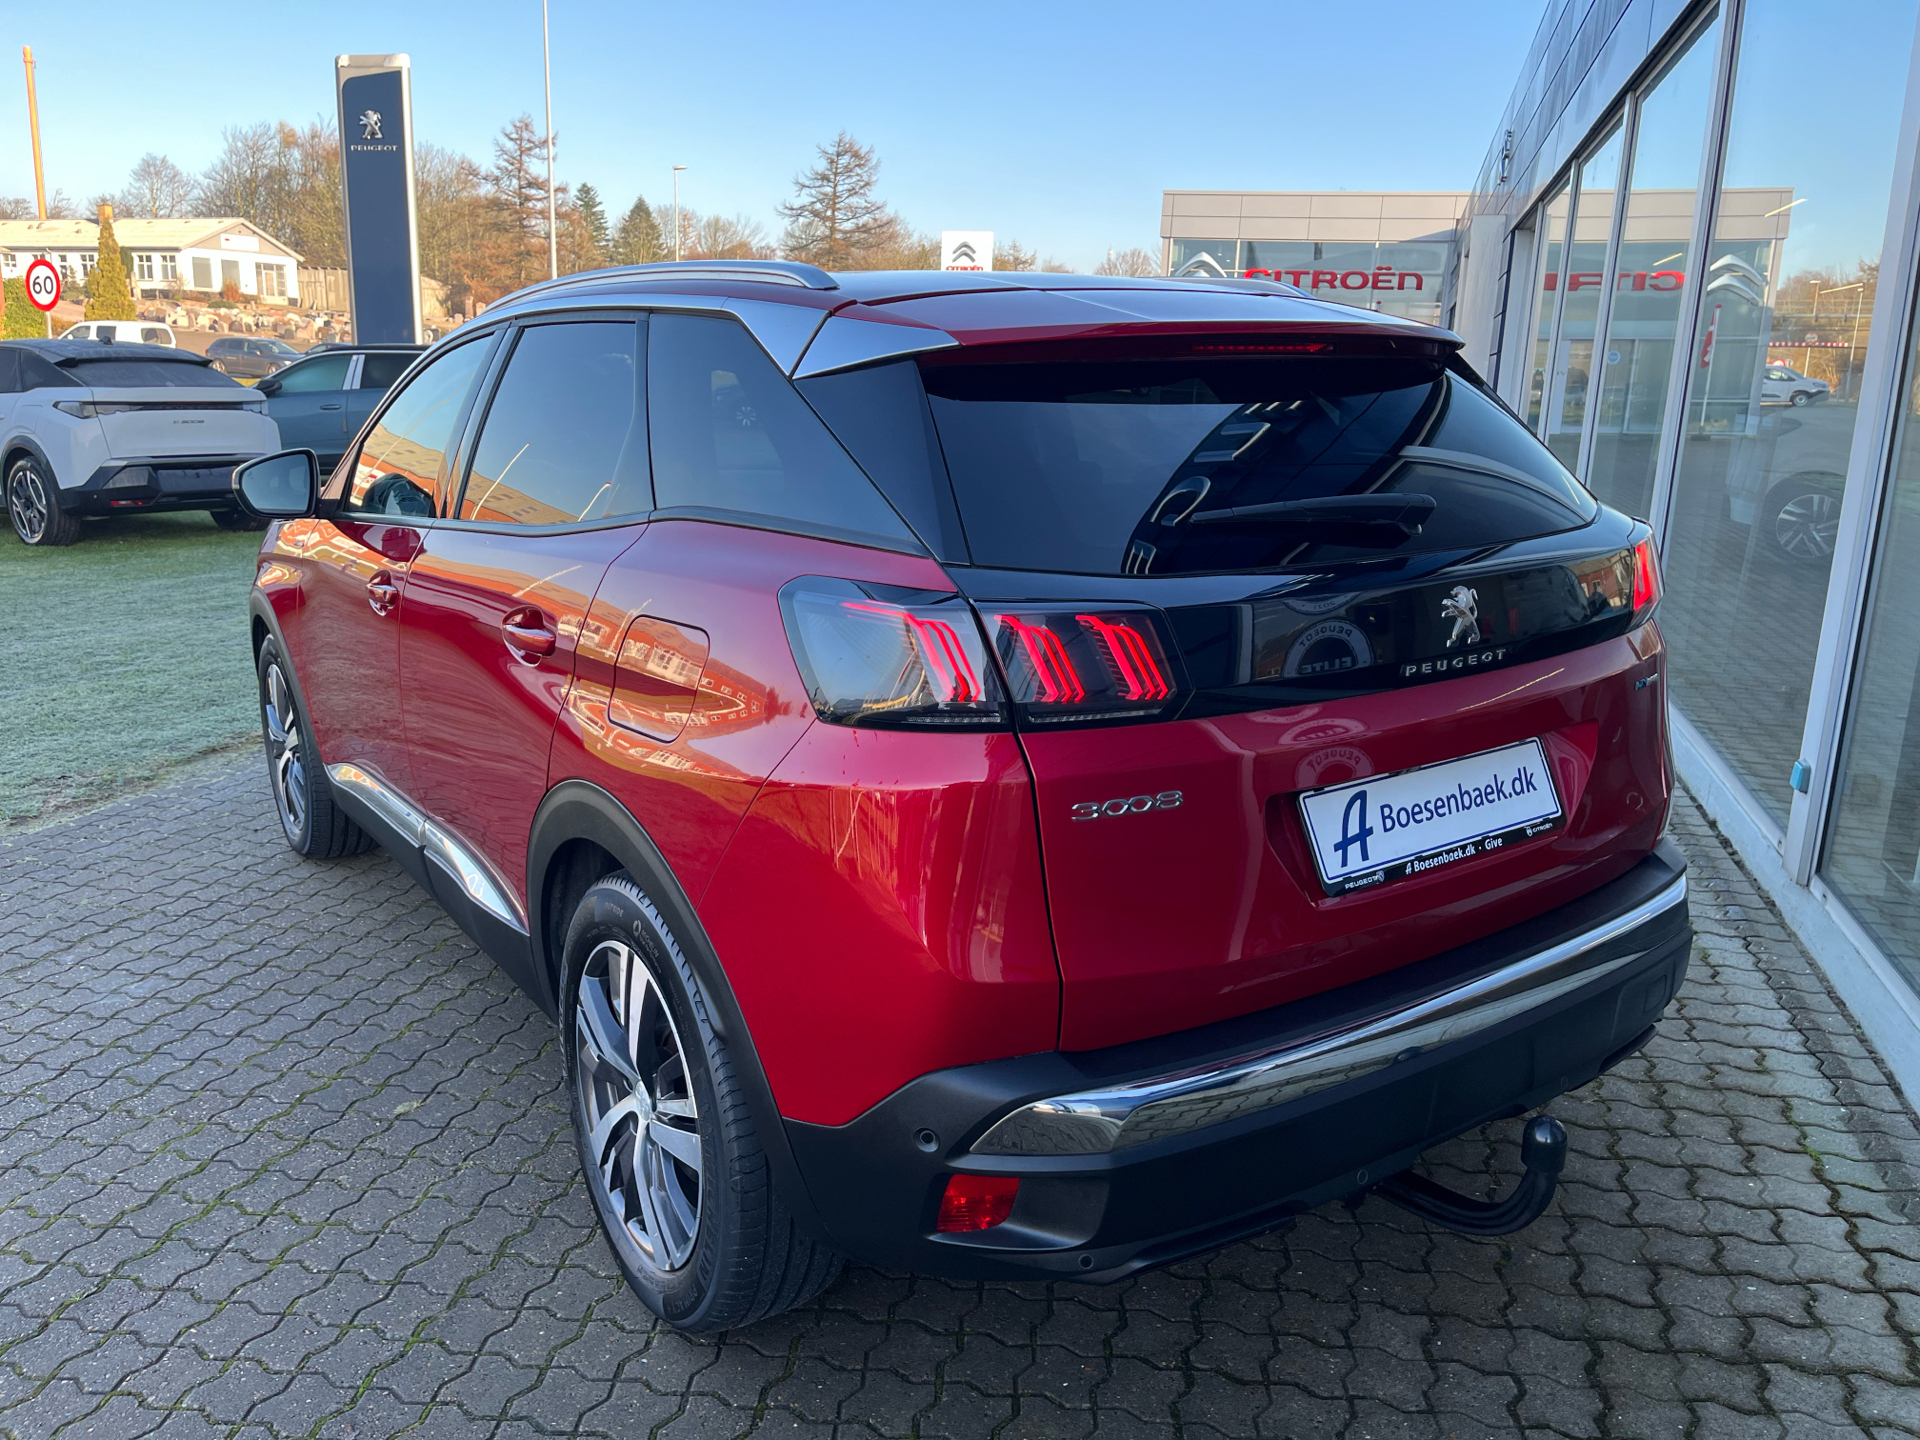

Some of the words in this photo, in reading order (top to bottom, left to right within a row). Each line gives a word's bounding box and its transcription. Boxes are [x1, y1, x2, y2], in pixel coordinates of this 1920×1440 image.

[350, 144, 398, 152] PEUGEOT
[32, 275, 54, 295] 60
[1405, 649, 1506, 677] PEUGEOT
[1071, 790, 1184, 821] 3008
[1380, 765, 1538, 833] Boesenbaek.dk
[1413, 844, 1476, 872] Boesenbaek.dk
[1485, 837, 1503, 850] Give
[1344, 875, 1378, 890] PEUGEOT
[641, 929, 660, 958] MICHELIN
